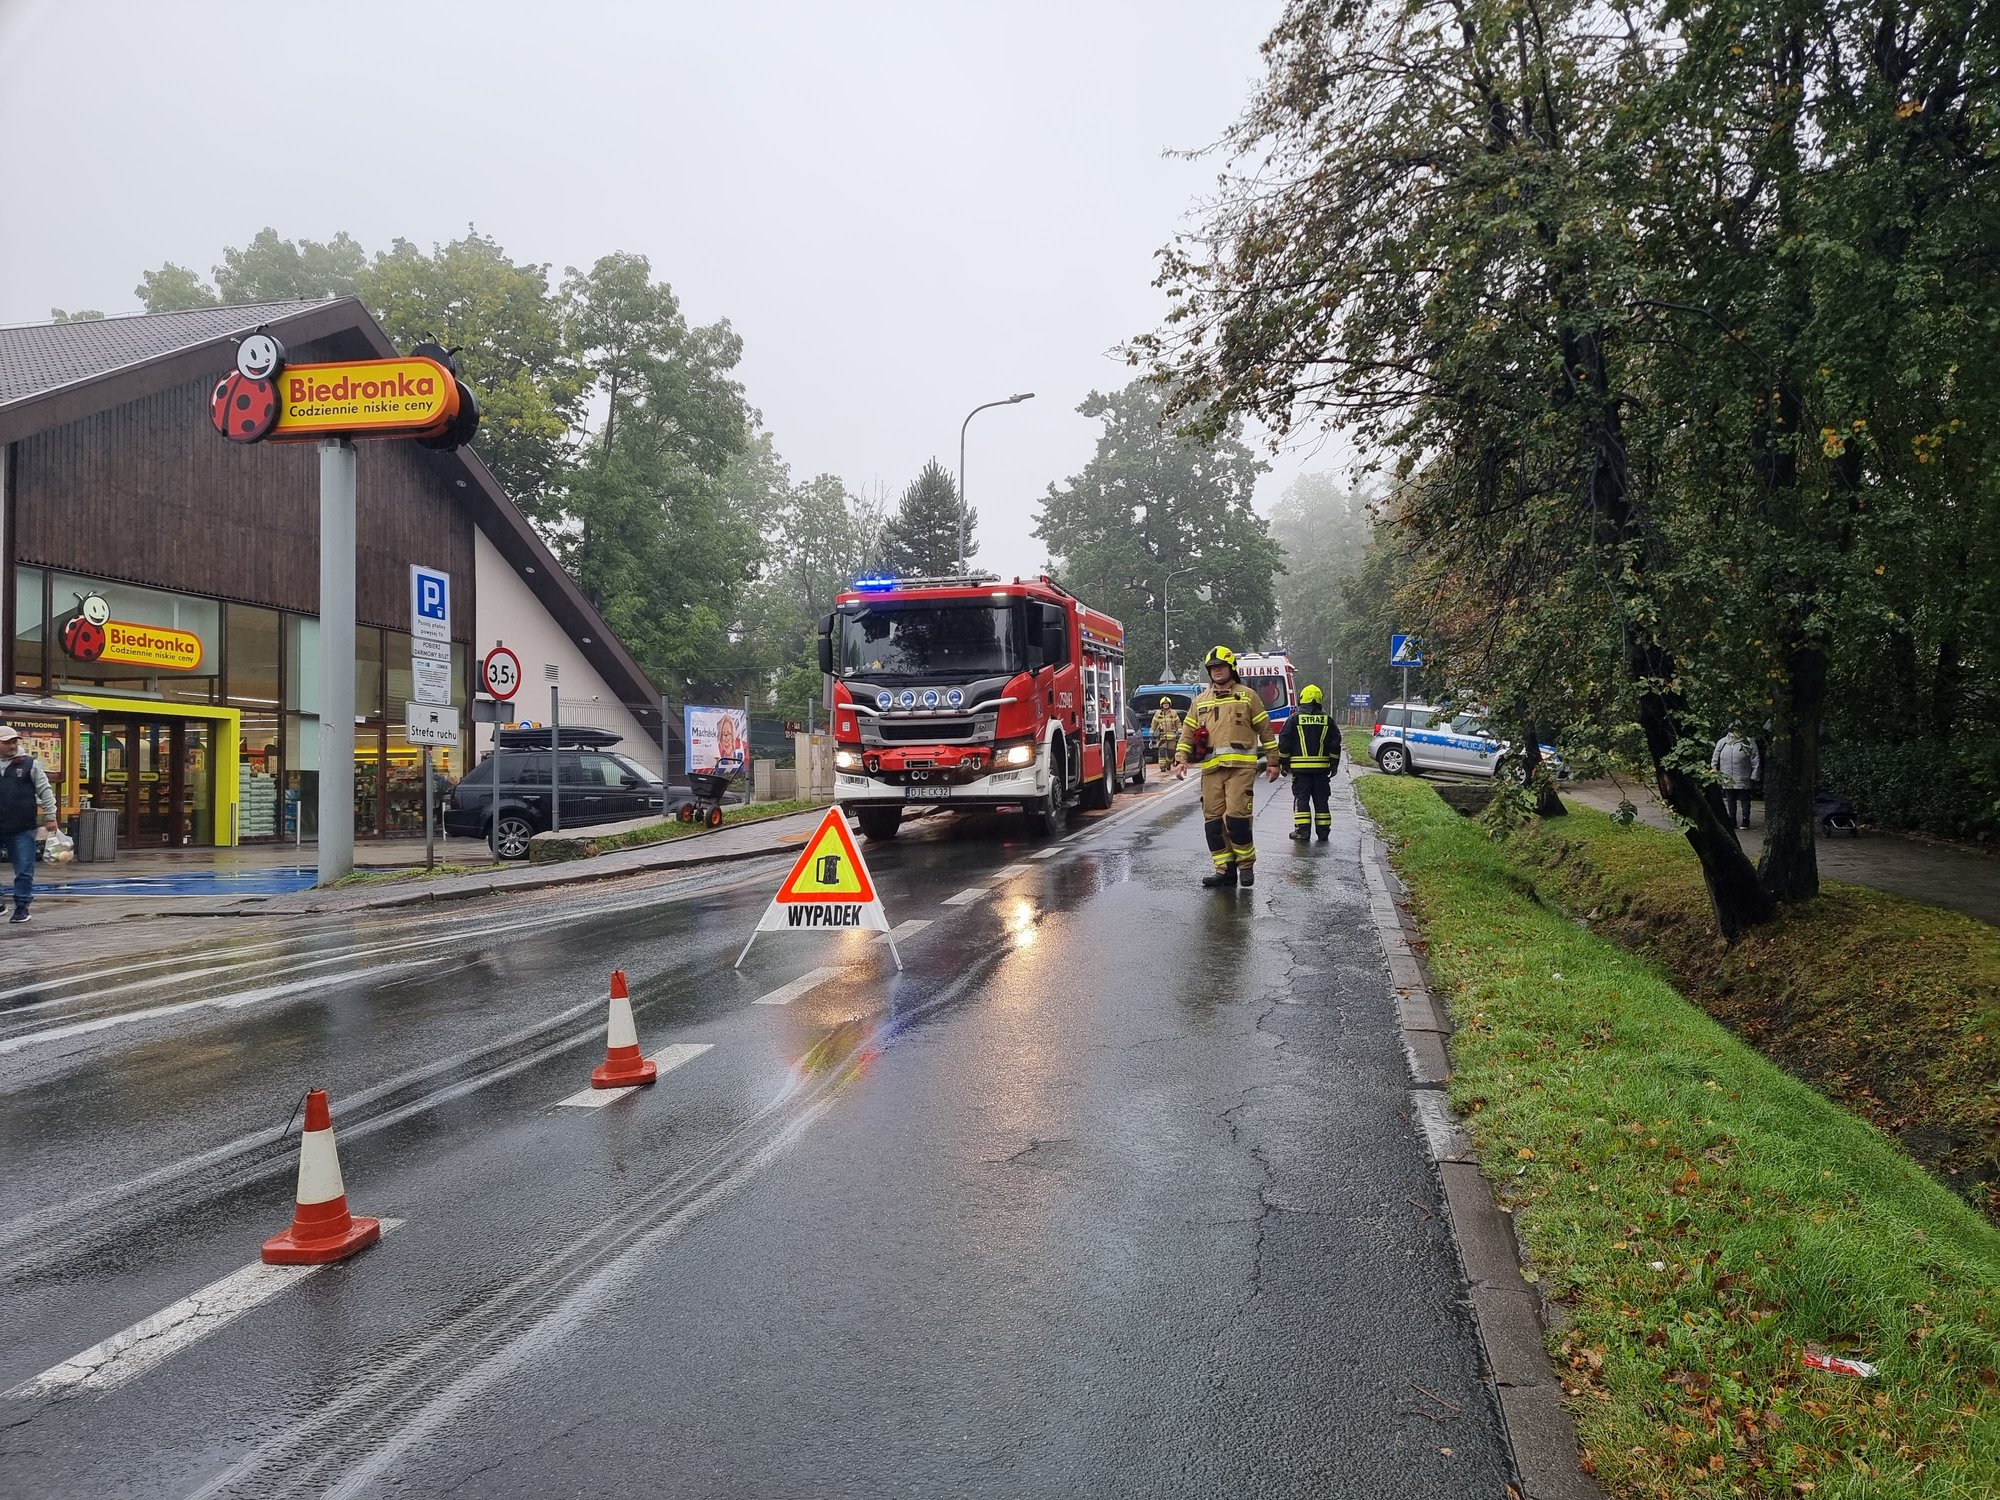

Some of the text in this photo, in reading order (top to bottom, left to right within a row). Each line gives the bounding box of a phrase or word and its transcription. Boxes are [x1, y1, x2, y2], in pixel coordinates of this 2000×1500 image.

[289, 372, 434, 403] Biedronka
[289, 399, 434, 417] Codziennie niskie ceny
[423, 579, 440, 613] P
[110, 628, 195, 654] Biedronka
[110, 645, 194, 663] Codziennie niskie ceny
[414, 649, 449, 660] DARMOWY BILET
[1239, 666, 1280, 676] BULANS
[27, 721, 59, 729] TYGODNIU
[411, 725, 457, 740] Strefa ruchu
[787, 904, 863, 926] WYPADEK
